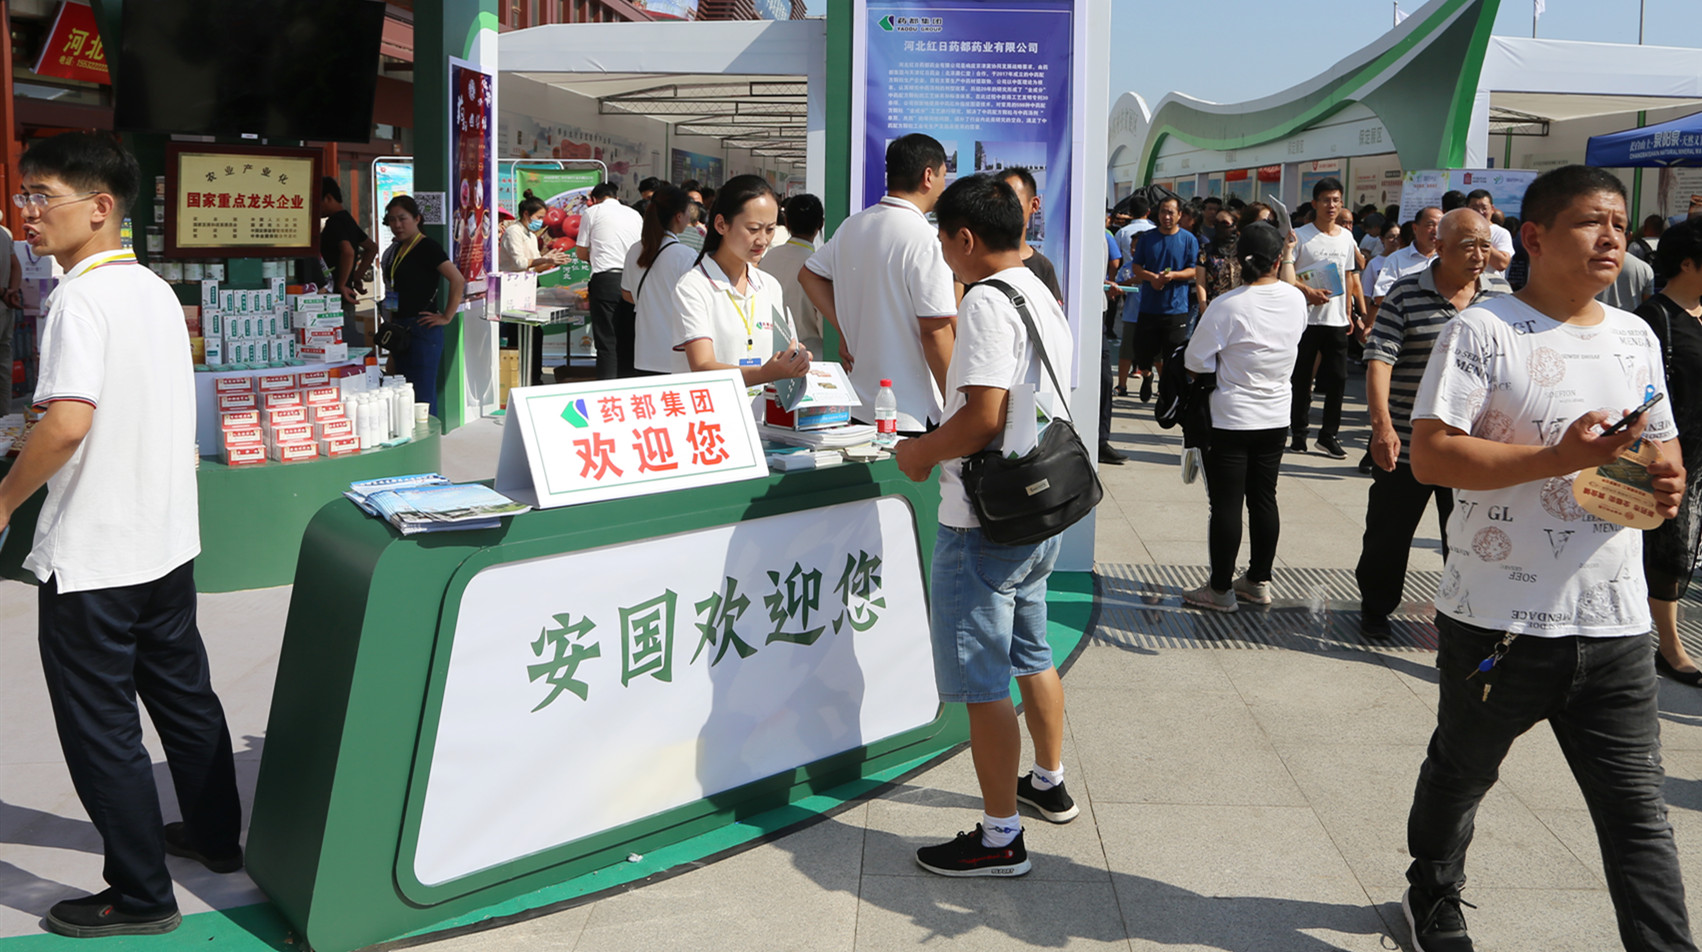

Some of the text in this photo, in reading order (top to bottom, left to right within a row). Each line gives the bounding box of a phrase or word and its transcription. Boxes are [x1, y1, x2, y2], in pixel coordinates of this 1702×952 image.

[63, 28, 104, 60] 河北
[904, 40, 1039, 54] 河北红日药都药业有限公司
[205, 163, 288, 185] 农业产业化
[187, 192, 304, 209] 国家重点龙头企业
[597, 388, 715, 424] 药都集团
[572, 420, 730, 481] 欢迎您
[1487, 505, 1513, 522] GL
[526, 549, 887, 713] 安国欢迎您
